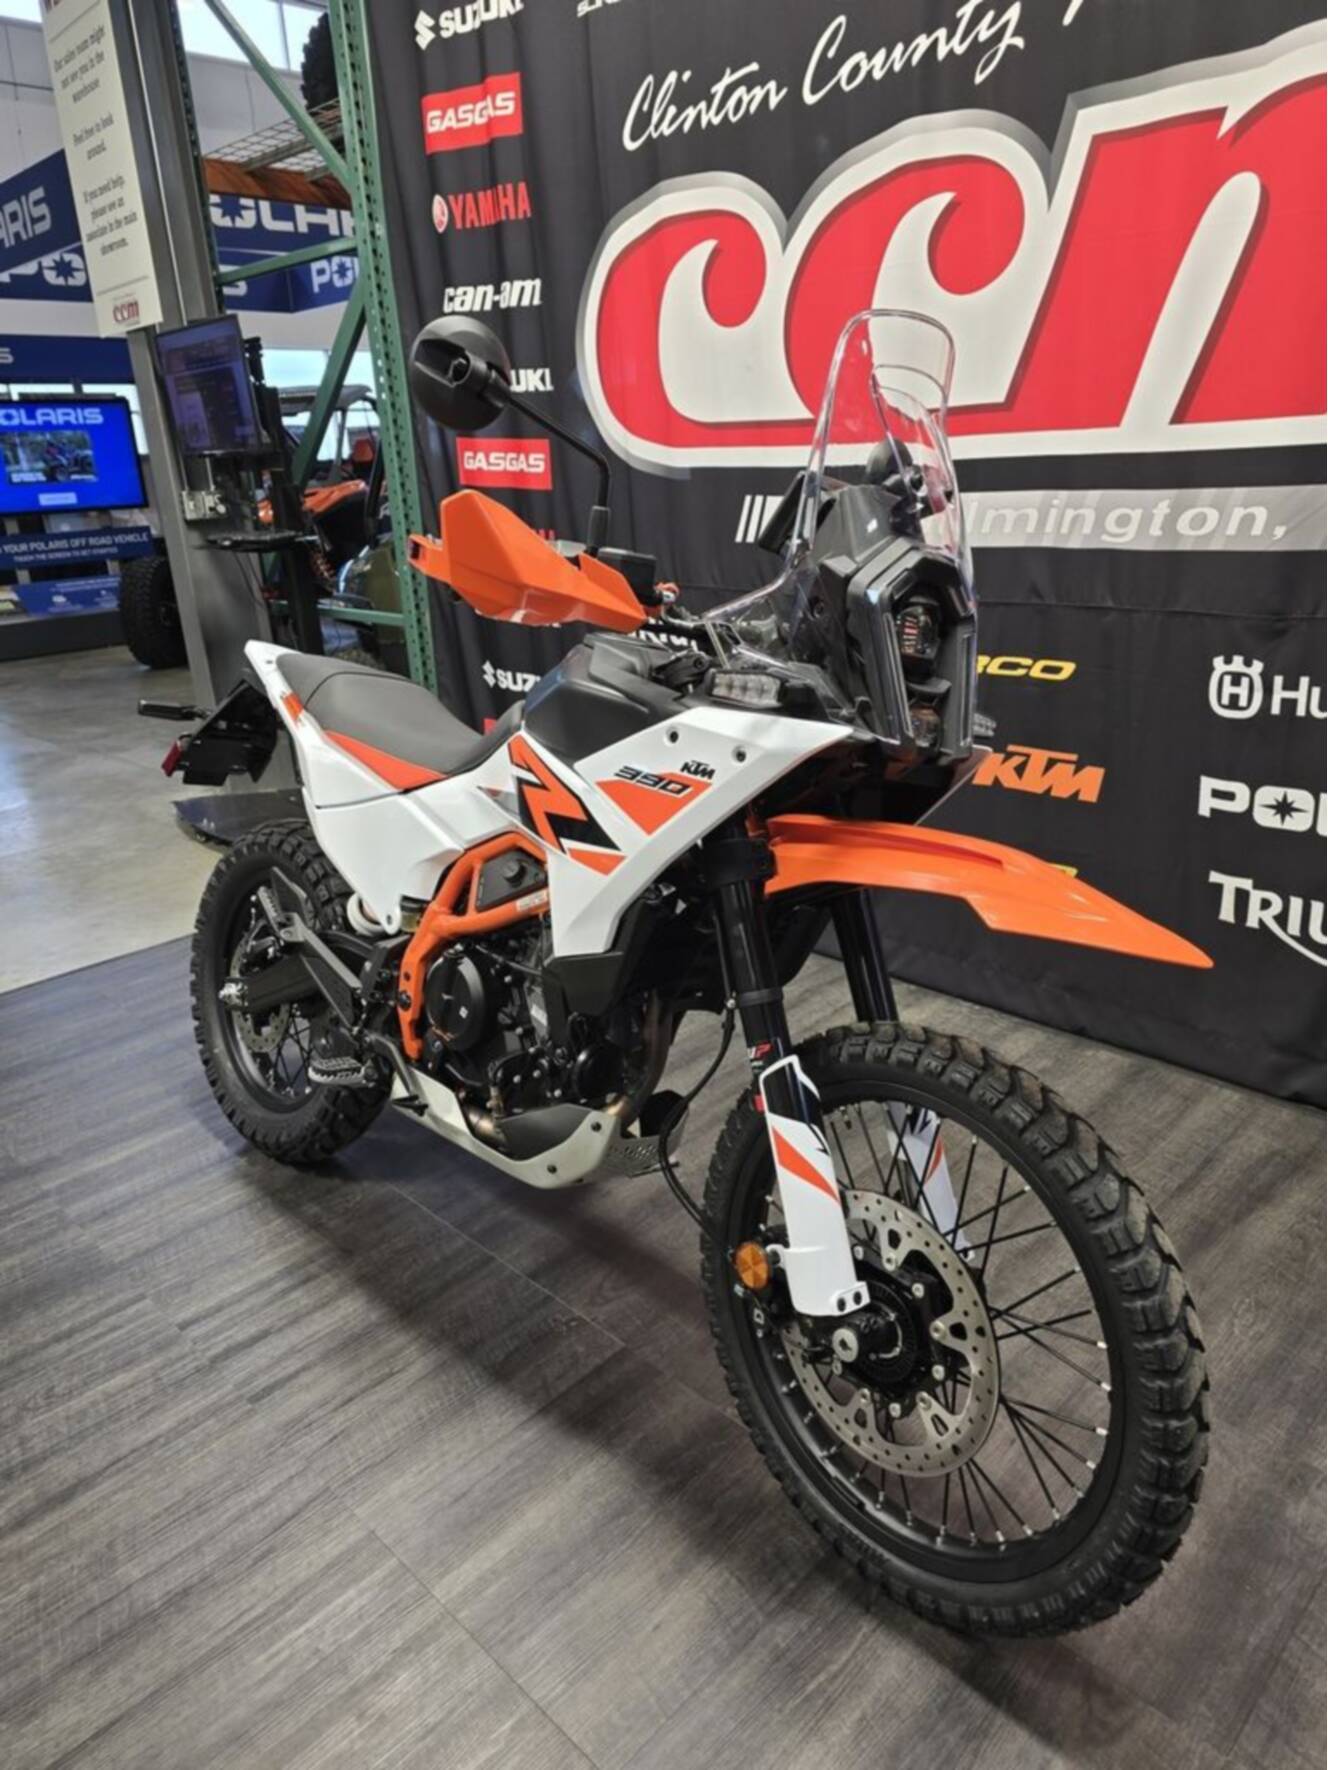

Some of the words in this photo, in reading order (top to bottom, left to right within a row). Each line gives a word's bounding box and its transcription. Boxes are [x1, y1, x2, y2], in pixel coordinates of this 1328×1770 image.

[622, 62, 788, 151] Clinton
[801, 0, 1025, 105] County
[448, 182, 531, 230] YAMAHA
[443, 278, 542, 313] can-am
[463, 450, 546, 474] GASGAS
[495, 668, 541, 692] SUZ
[680, 760, 716, 780] KTM
[971, 744, 1105, 803] KTM
